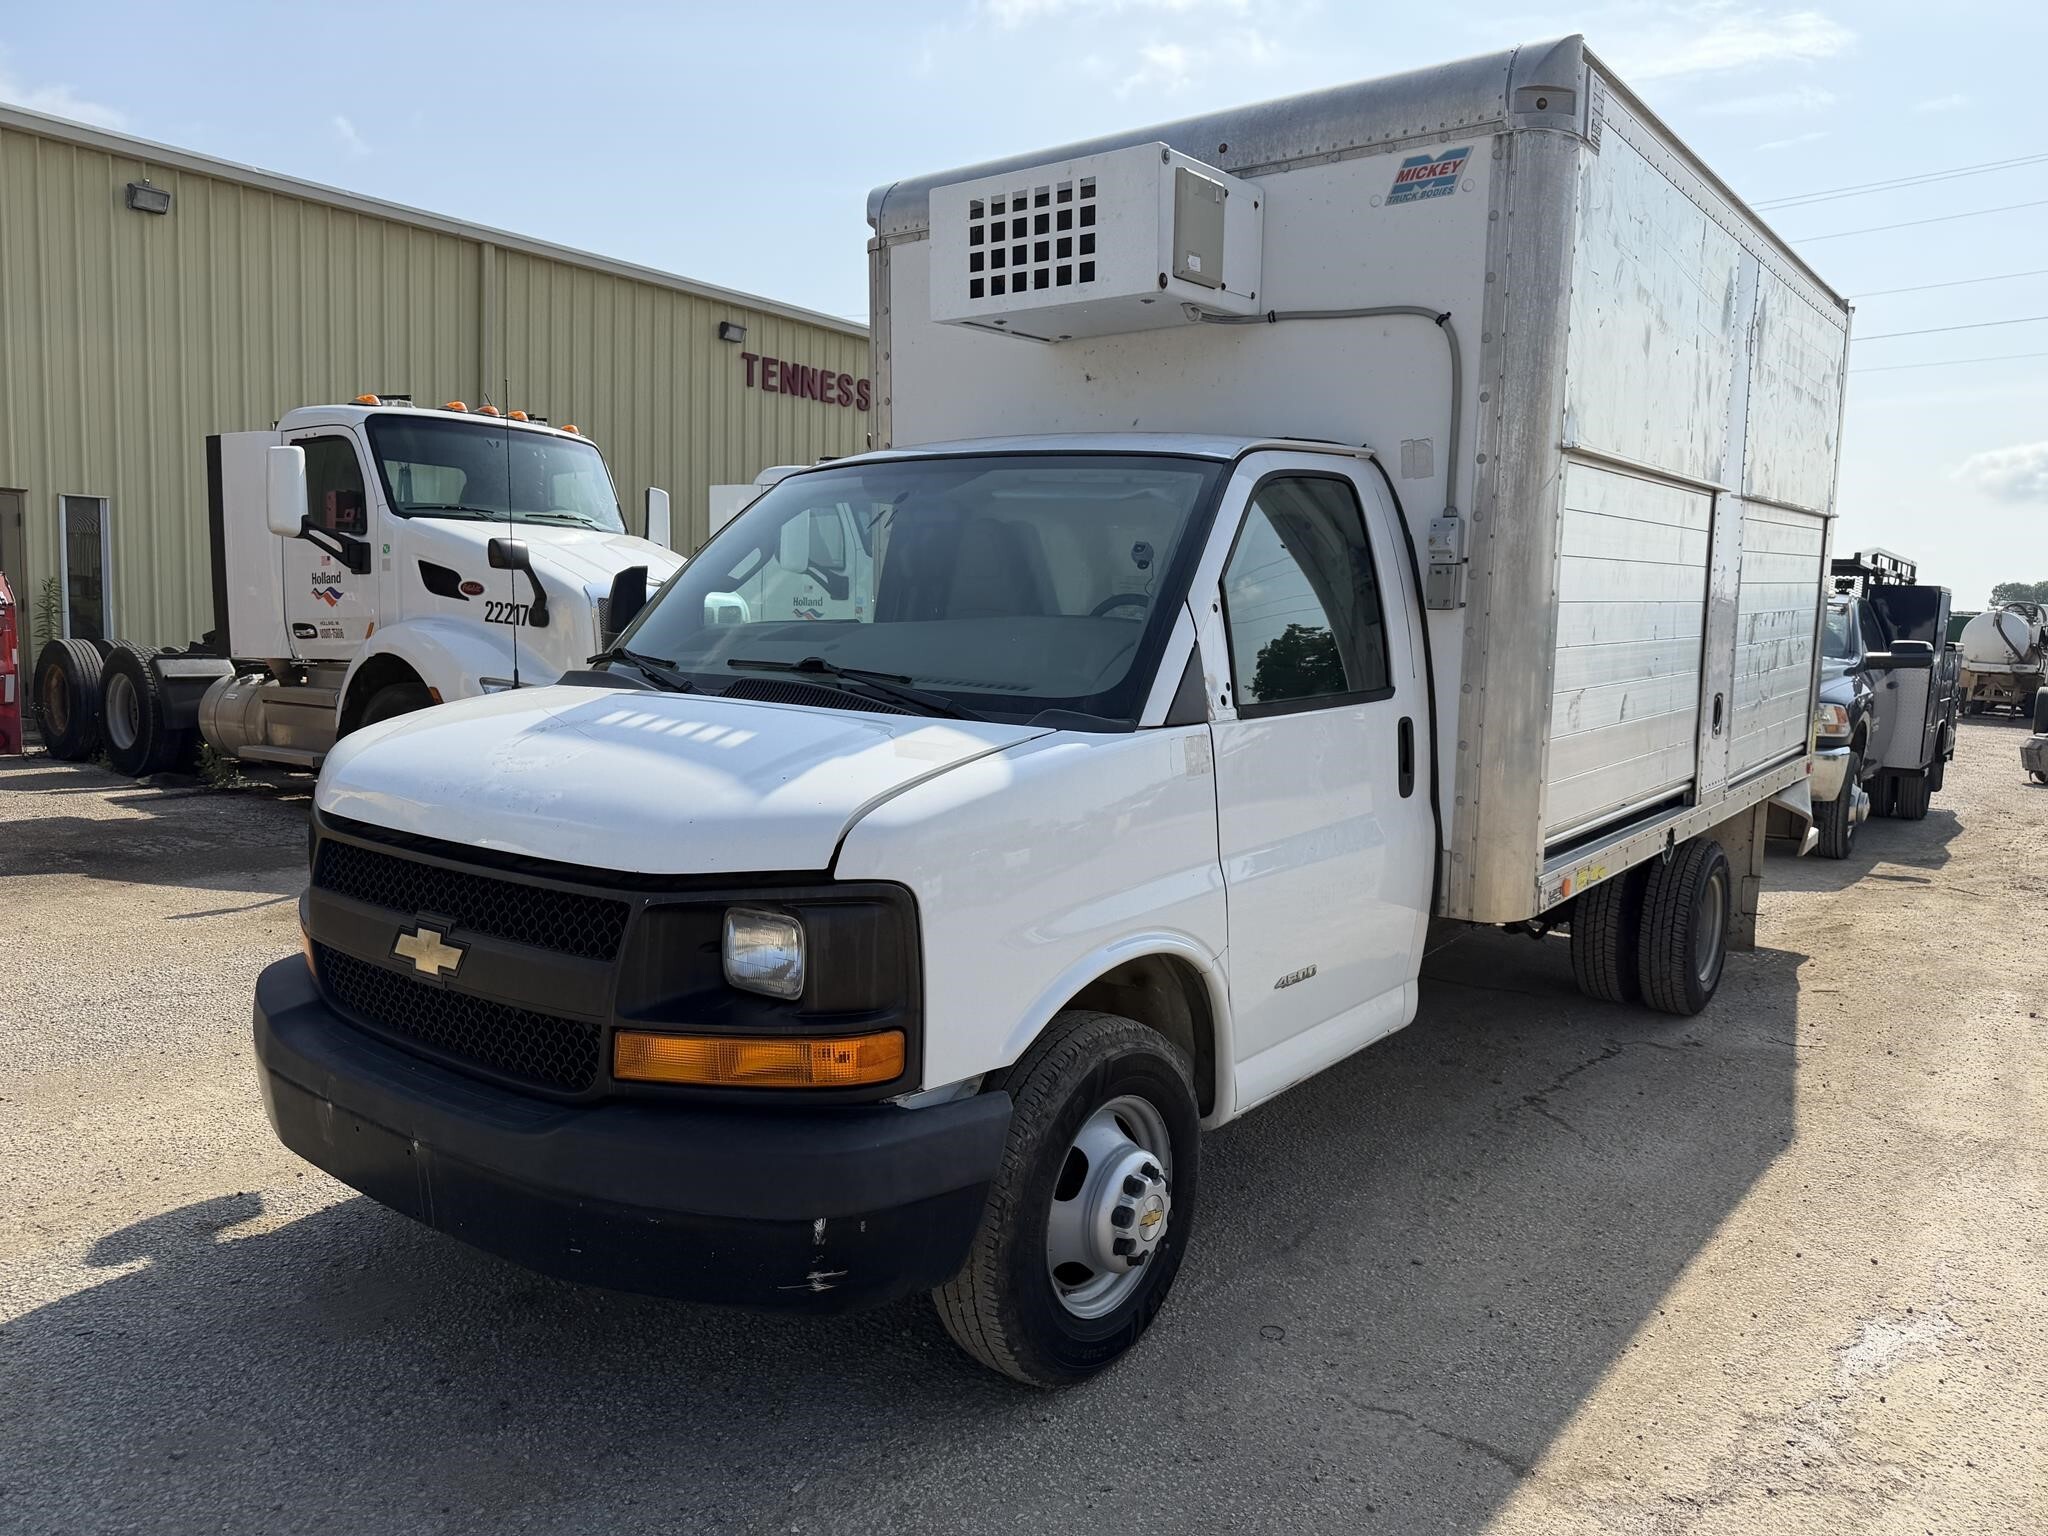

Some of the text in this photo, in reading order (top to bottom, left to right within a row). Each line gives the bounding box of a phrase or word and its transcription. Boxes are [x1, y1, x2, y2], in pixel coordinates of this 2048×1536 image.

[1396, 158, 1465, 183] MICKEY
[1388, 185, 1455, 205] TRUCK BODIES
[741, 351, 871, 412] TENNESS
[311, 571, 342, 585] Holland
[793, 596, 823, 607] Holland
[484, 600, 530, 627] 22217
